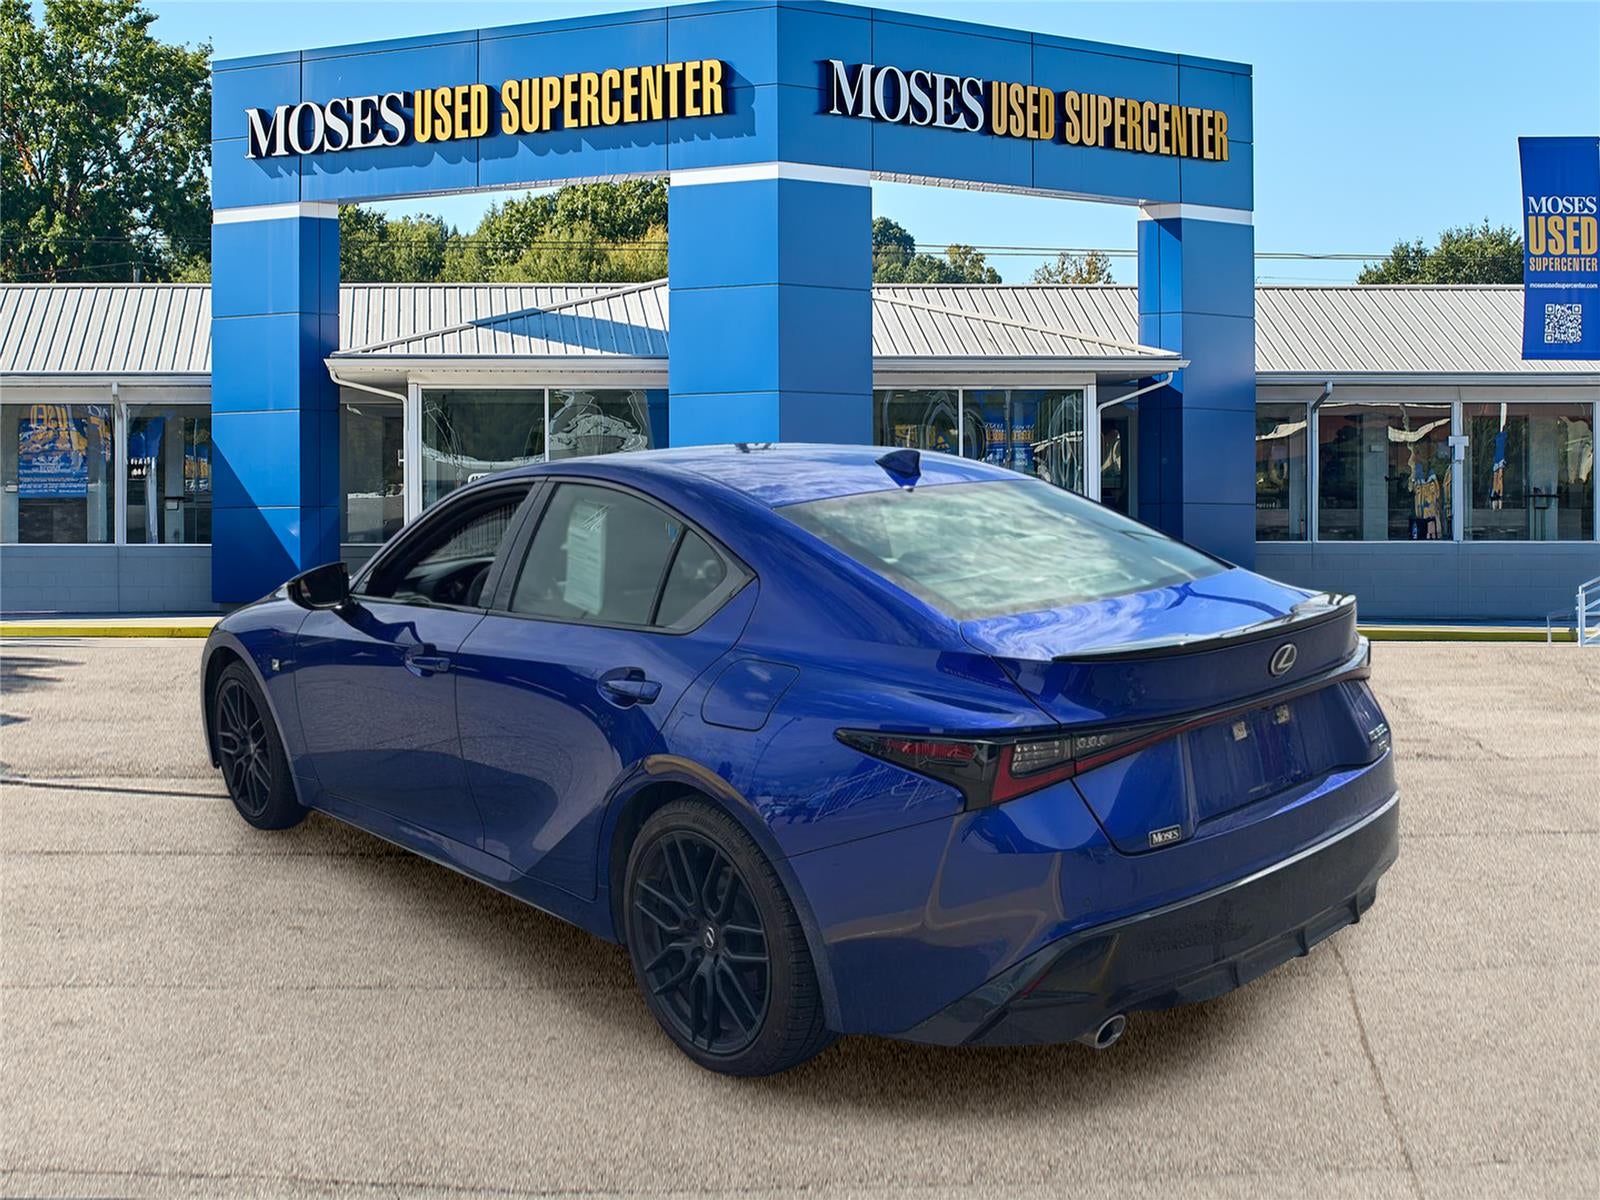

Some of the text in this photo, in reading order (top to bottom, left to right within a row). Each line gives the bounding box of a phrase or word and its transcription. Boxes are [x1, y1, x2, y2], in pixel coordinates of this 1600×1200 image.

[245, 58, 724, 160] MOSES USED SUPERCENTER
[827, 59, 1230, 162] MOSES USED SUPERCENTER
[1528, 196, 1597, 214] MOSES
[1528, 216, 1598, 255] USED
[1529, 257, 1598, 272] SUPERCENTER
